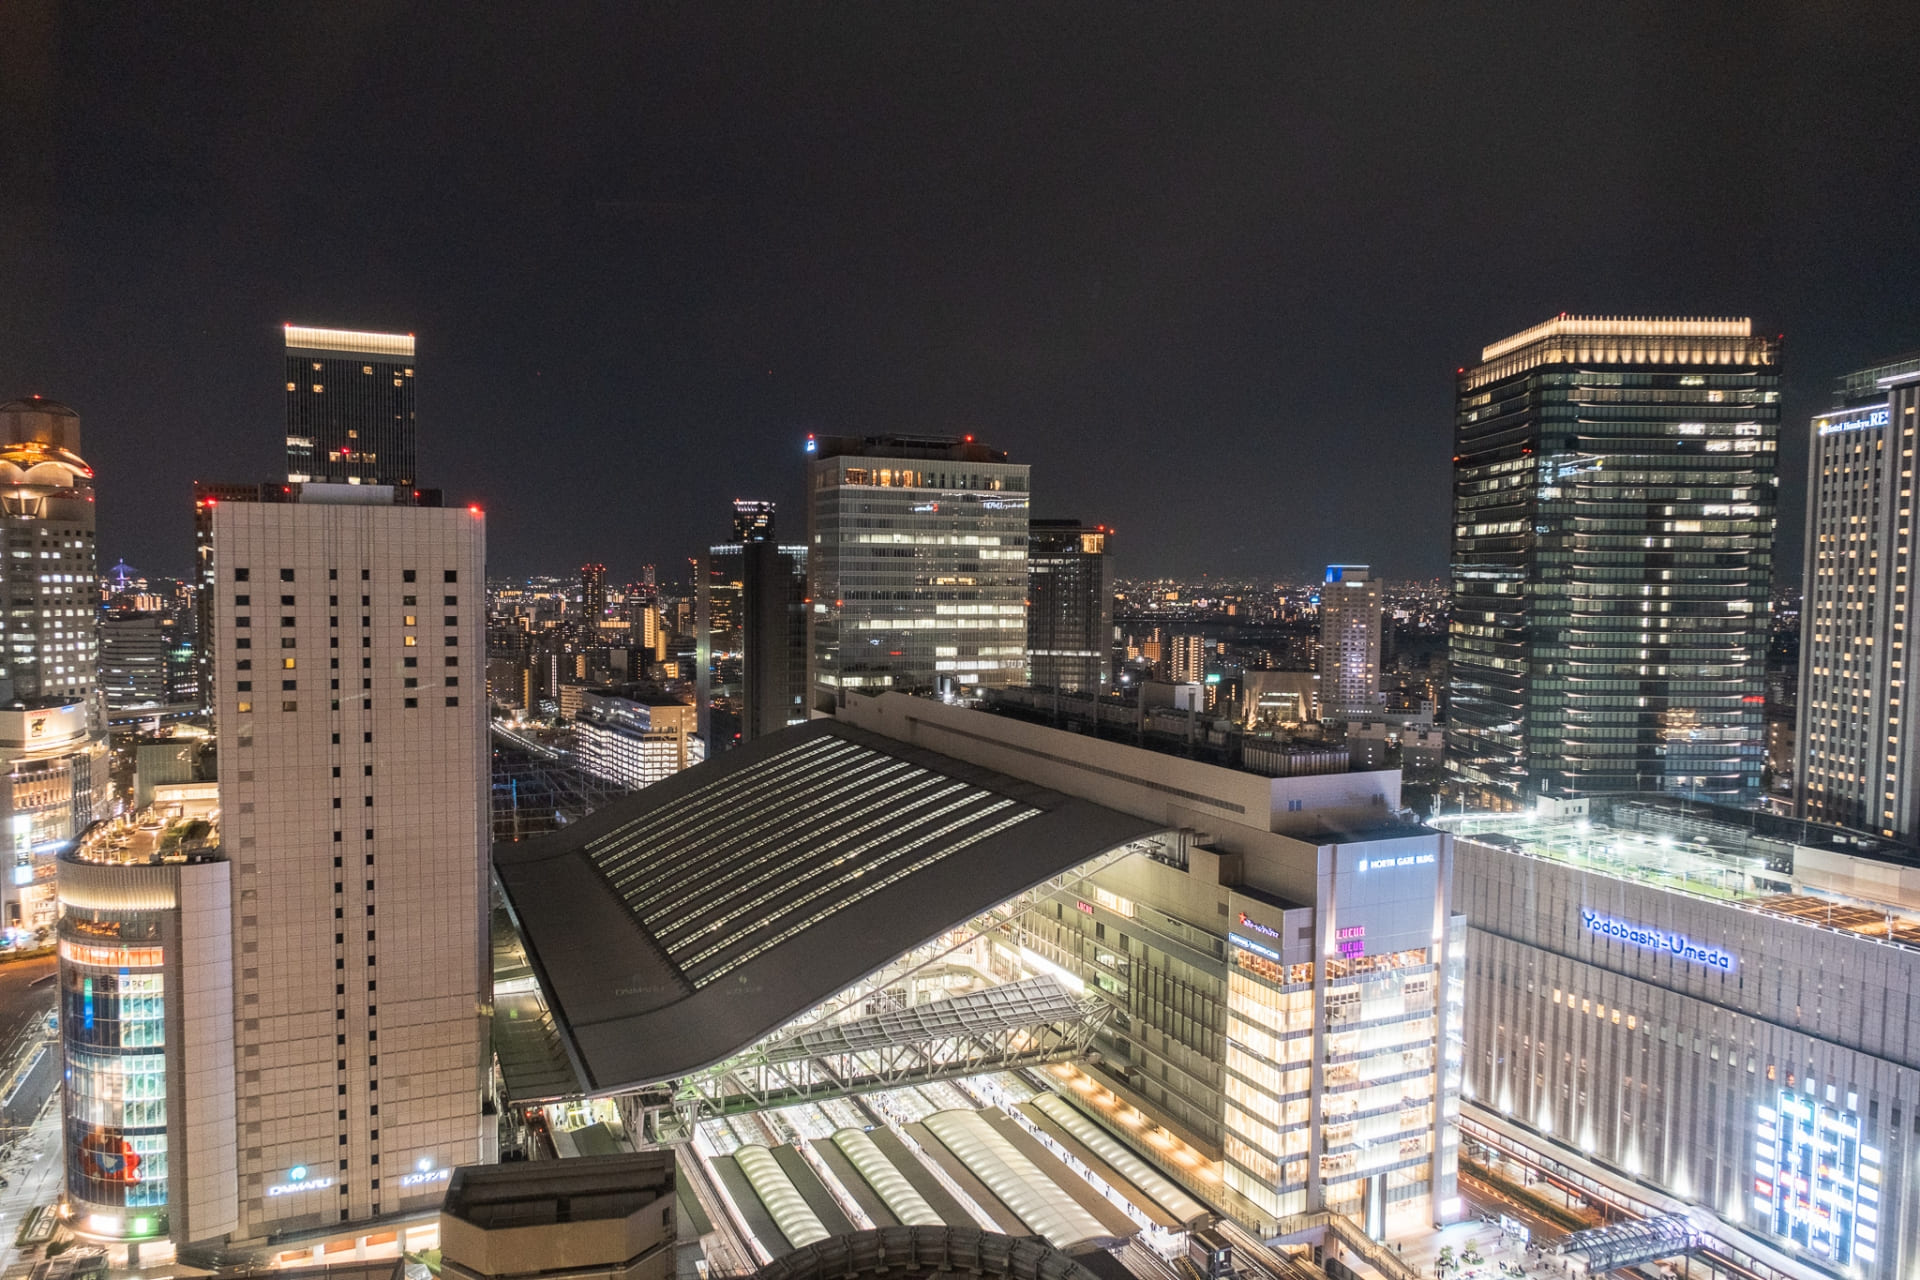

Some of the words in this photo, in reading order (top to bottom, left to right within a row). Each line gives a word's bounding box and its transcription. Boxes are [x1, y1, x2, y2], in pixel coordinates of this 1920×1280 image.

[1370, 858, 1396, 869] NORTH
[1397, 856, 1415, 866] GATE
[1582, 911, 1729, 969] Yodobashi-Umeda
[268, 1178, 332, 1197] DAIMARU
